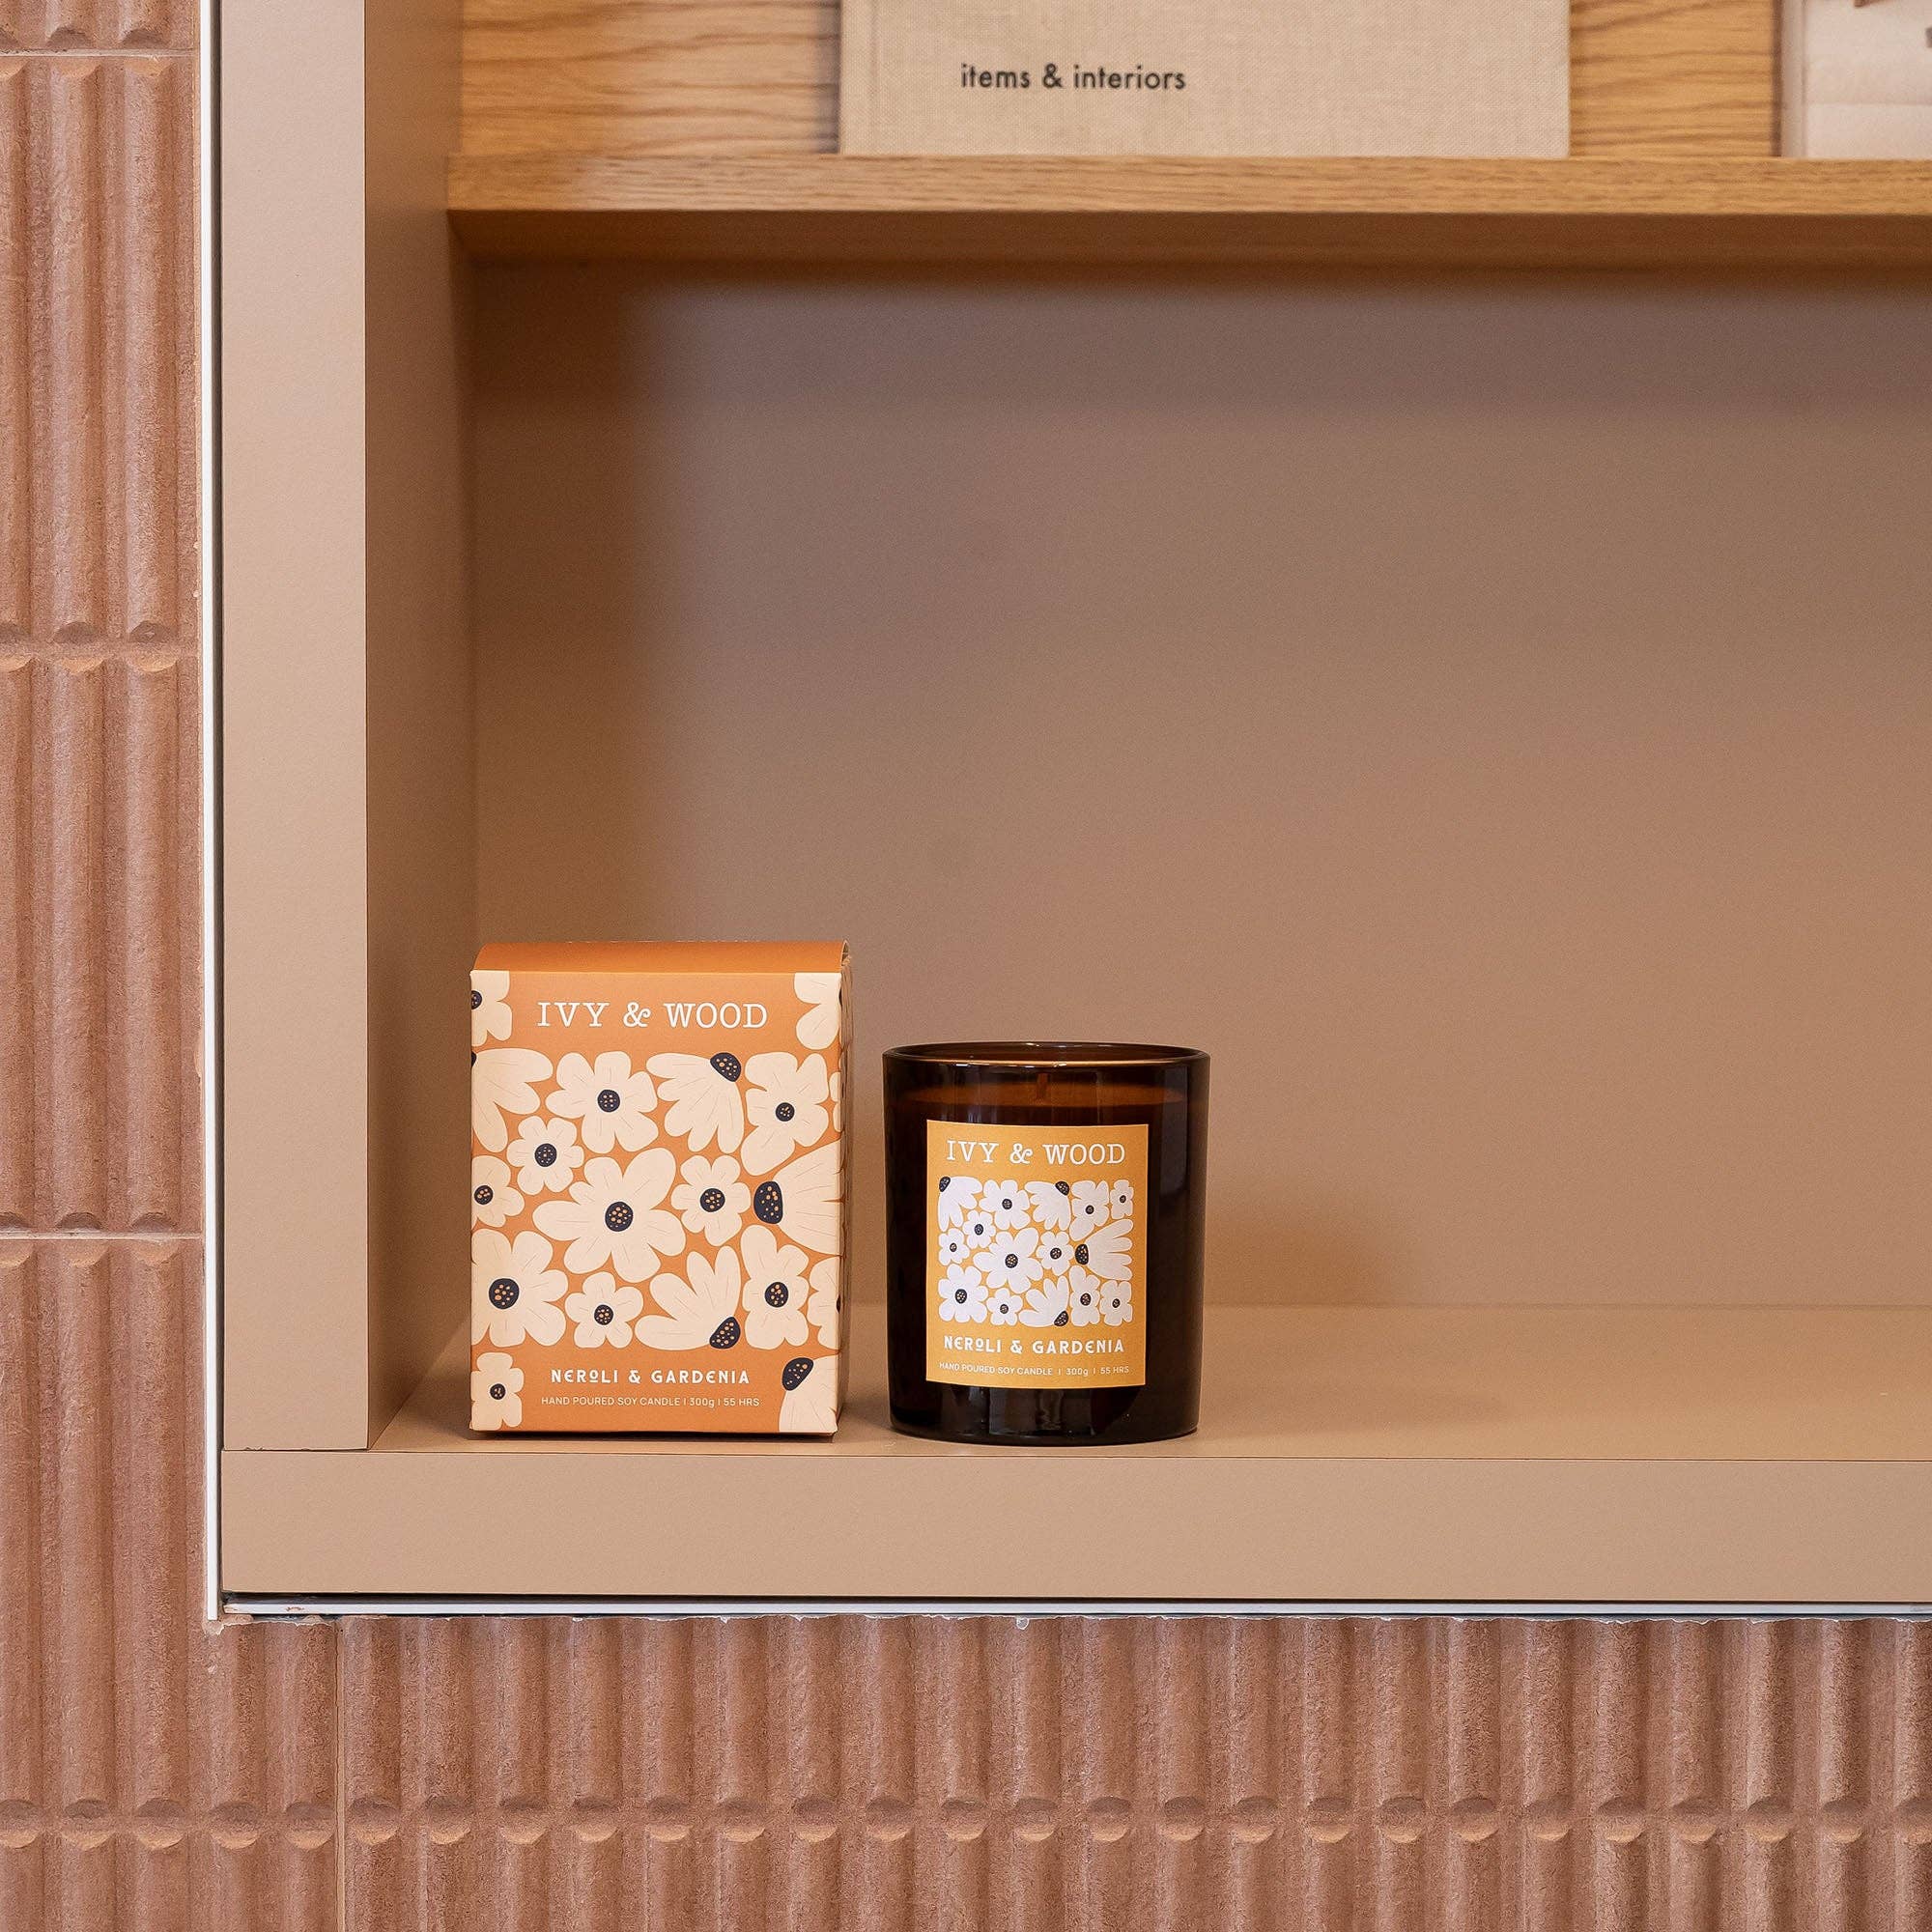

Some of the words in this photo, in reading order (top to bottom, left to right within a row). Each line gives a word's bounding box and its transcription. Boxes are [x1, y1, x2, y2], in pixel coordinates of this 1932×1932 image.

[960, 63, 1031, 89] items
[1042, 63, 1064, 89] &
[1073, 65, 1186, 90] interiors
[537, 1002, 610, 1028] IVY
[623, 1002, 651, 1028] &
[664, 1002, 768, 1029] WOOD
[947, 1140, 999, 1164] IVY
[1009, 1143, 1034, 1165] &
[1042, 1143, 1125, 1165] WOOD
[944, 1335, 1001, 1353] NEROLI
[1009, 1340, 1023, 1354] &
[1032, 1339, 1124, 1354] GARDENIA
[551, 1369, 619, 1383] NEROLI
[628, 1369, 641, 1384] &
[651, 1370, 750, 1384] GARDENIA
[939, 1361, 960, 1373] HAND
[961, 1363, 995, 1375] POURED
[997, 1367, 1015, 1376] SOY
[1016, 1367, 1053, 1377] CANDLE
[1065, 1367, 1089, 1378] 300g
[1100, 1366, 1112, 1376] 55
[1113, 1365, 1129, 1376] HRS
[541, 1397, 570, 1406] HAND
[572, 1397, 615, 1406] POURED
[617, 1397, 638, 1406] SOY
[639, 1397, 680, 1406] CANDLE
[689, 1397, 715, 1408] 300g
[724, 1398, 736, 1406] 55
[738, 1398, 760, 1406] HRS
